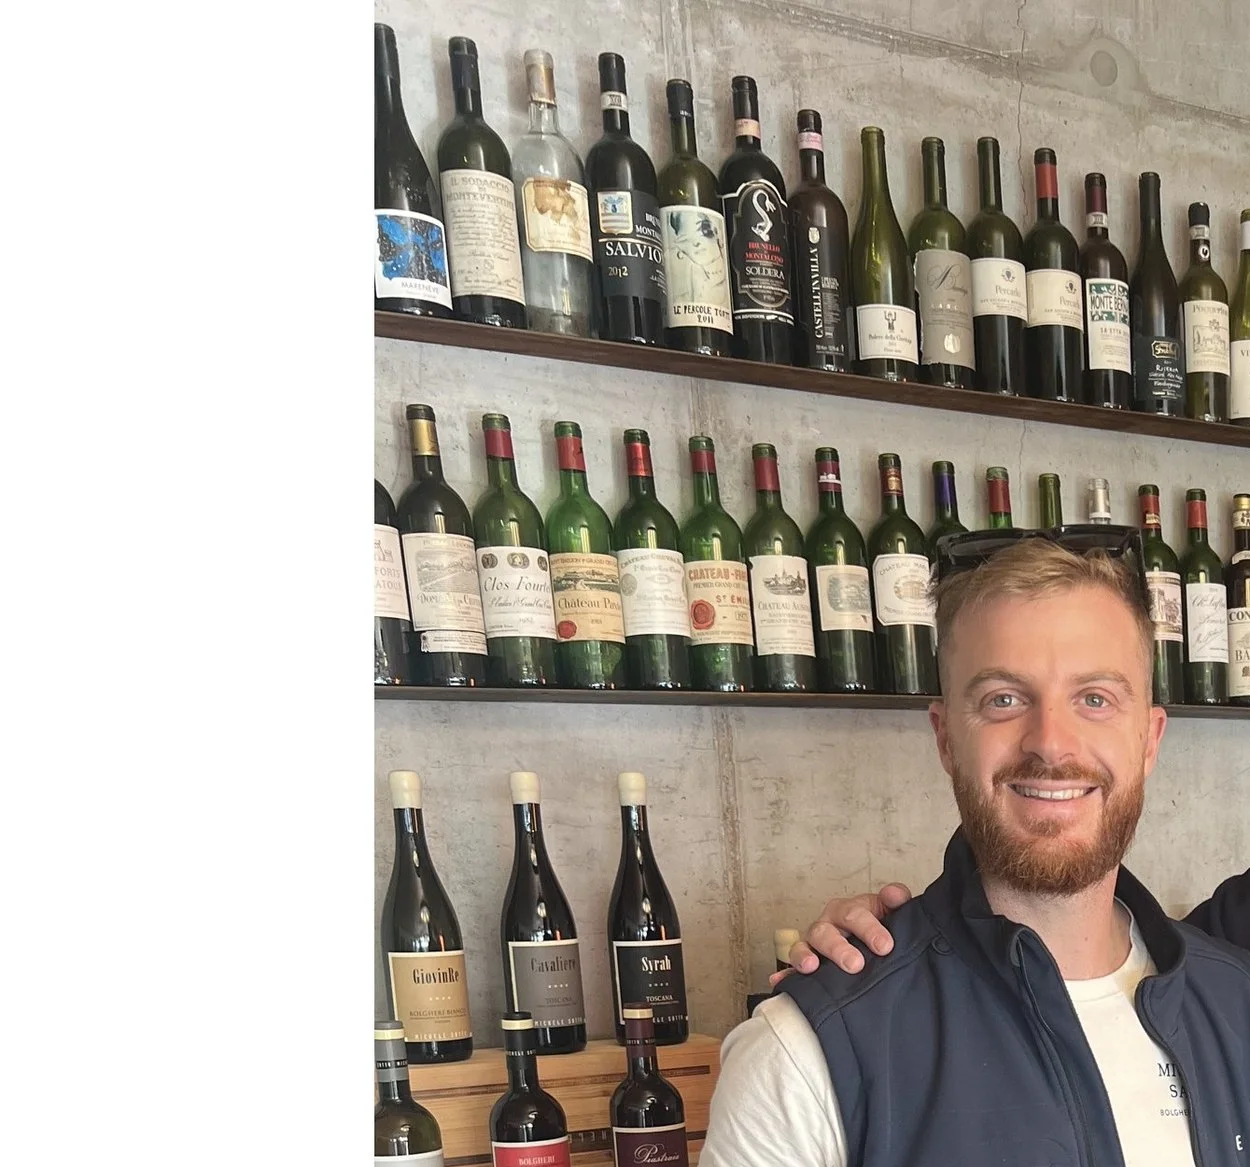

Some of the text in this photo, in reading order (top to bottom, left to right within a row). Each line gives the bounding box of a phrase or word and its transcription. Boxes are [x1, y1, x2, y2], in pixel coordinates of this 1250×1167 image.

[608, 266, 629, 278] 2012
[745, 266, 786, 280] SOLDERA
[1090, 295, 1113, 310] MONTE
[673, 305, 682, 315] LE
[483, 576, 510, 593] Clos
[530, 956, 577, 973] Cavaliere
[641, 955, 672, 976] Syrah
[412, 967, 460, 985] GiovinRe
[645, 994, 674, 1003] TOSCANA
[518, 1155, 556, 1166] BOLGHERI
